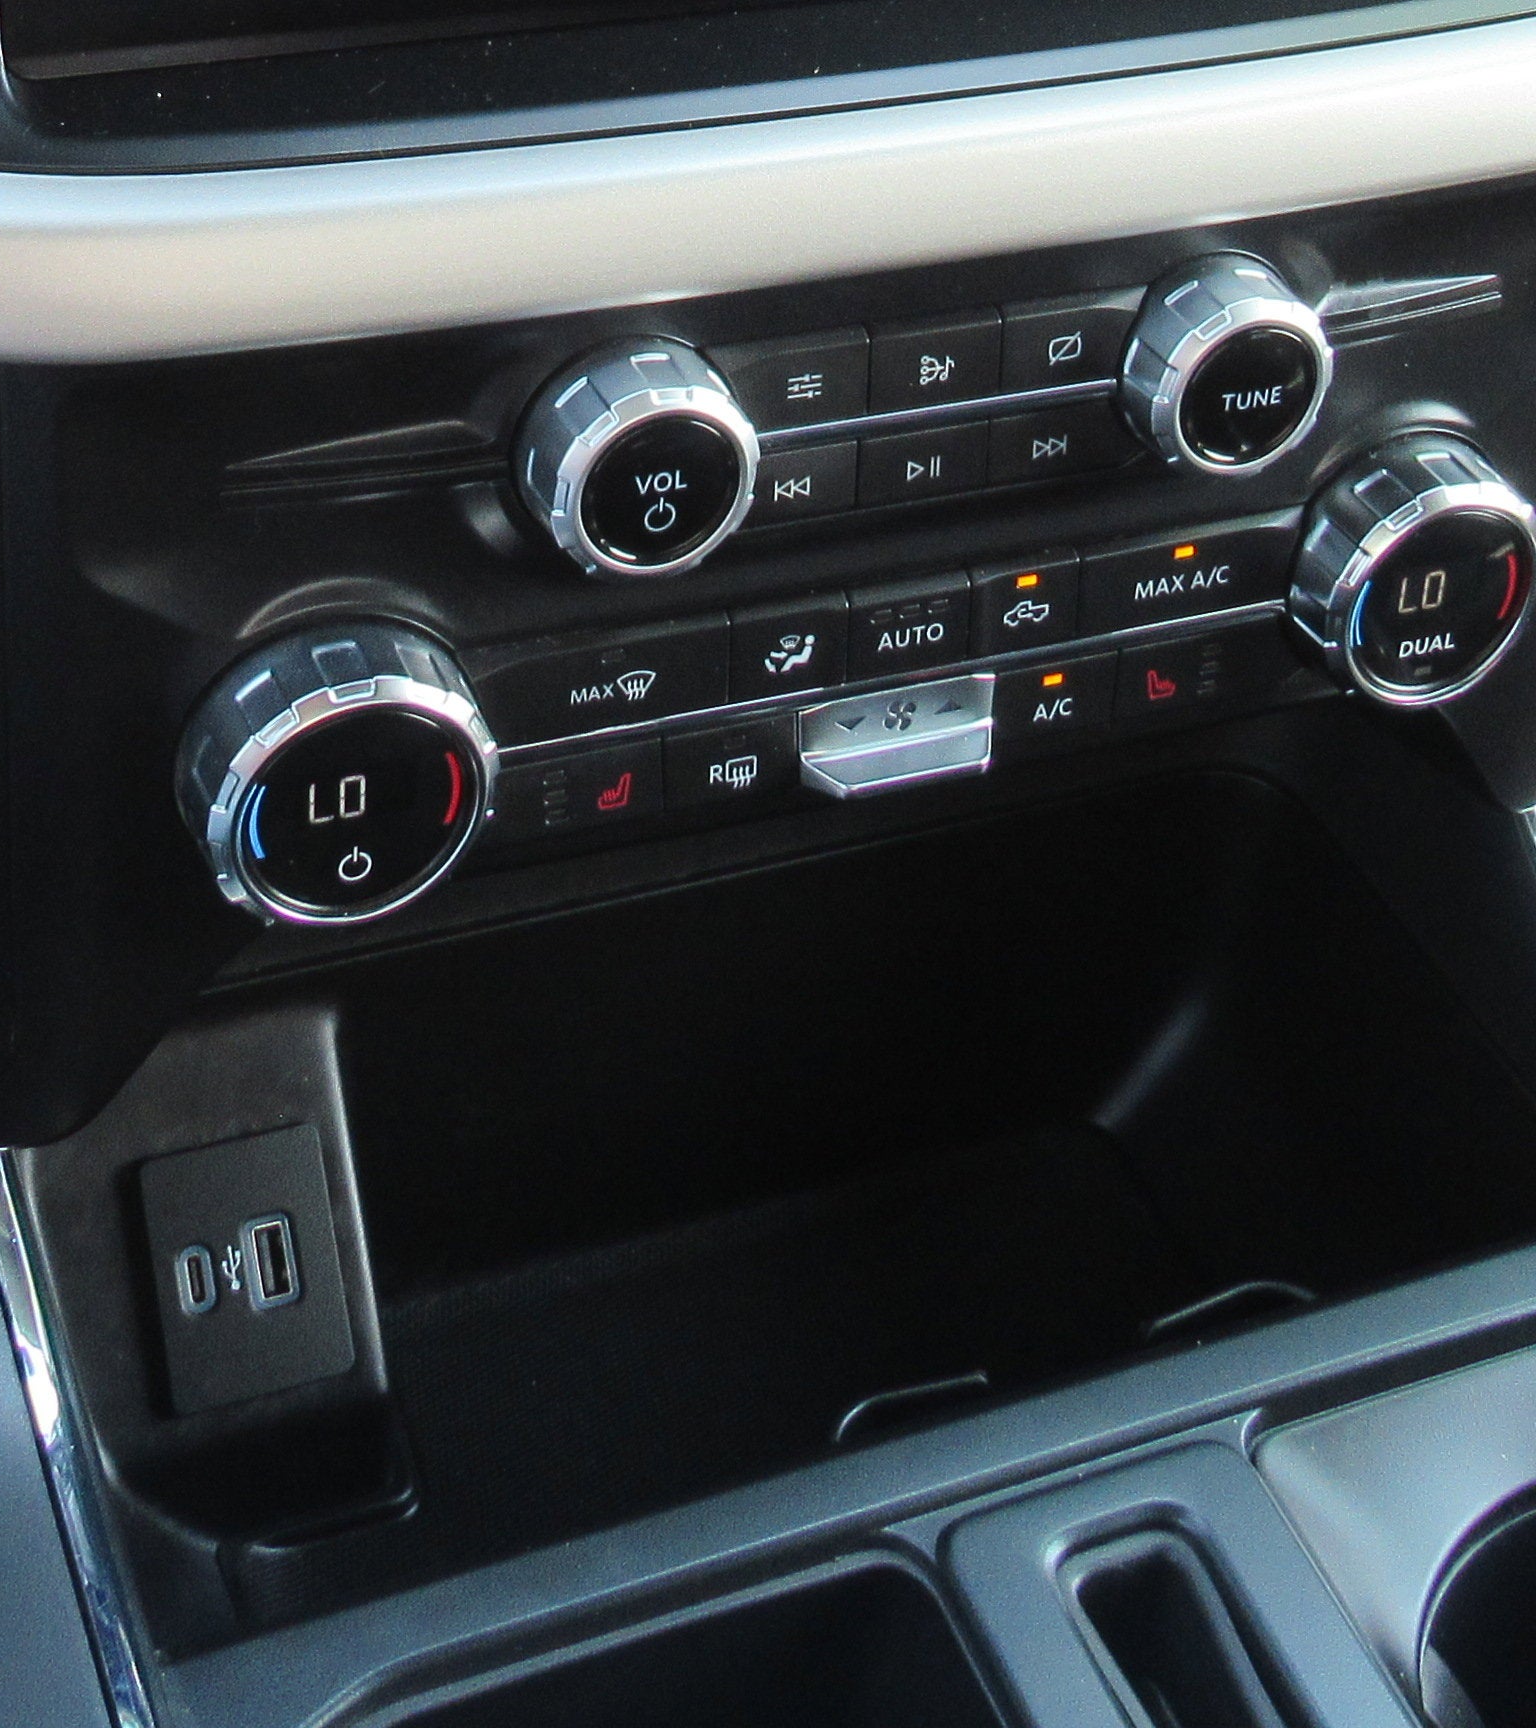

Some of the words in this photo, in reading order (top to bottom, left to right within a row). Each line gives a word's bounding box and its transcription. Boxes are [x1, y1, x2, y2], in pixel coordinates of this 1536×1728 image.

[1221, 384, 1283, 410] TUNE
[635, 469, 687, 494] VOL
[1133, 573, 1186, 600] MAX
[1191, 564, 1231, 590] A/C
[1397, 570, 1447, 615] LO
[878, 622, 945, 651] AUTO
[1397, 632, 1456, 658] DUAL
[570, 683, 615, 705] MAX
[1032, 696, 1074, 722] A/C
[710, 765, 723, 784] R
[309, 775, 366, 825] LO
